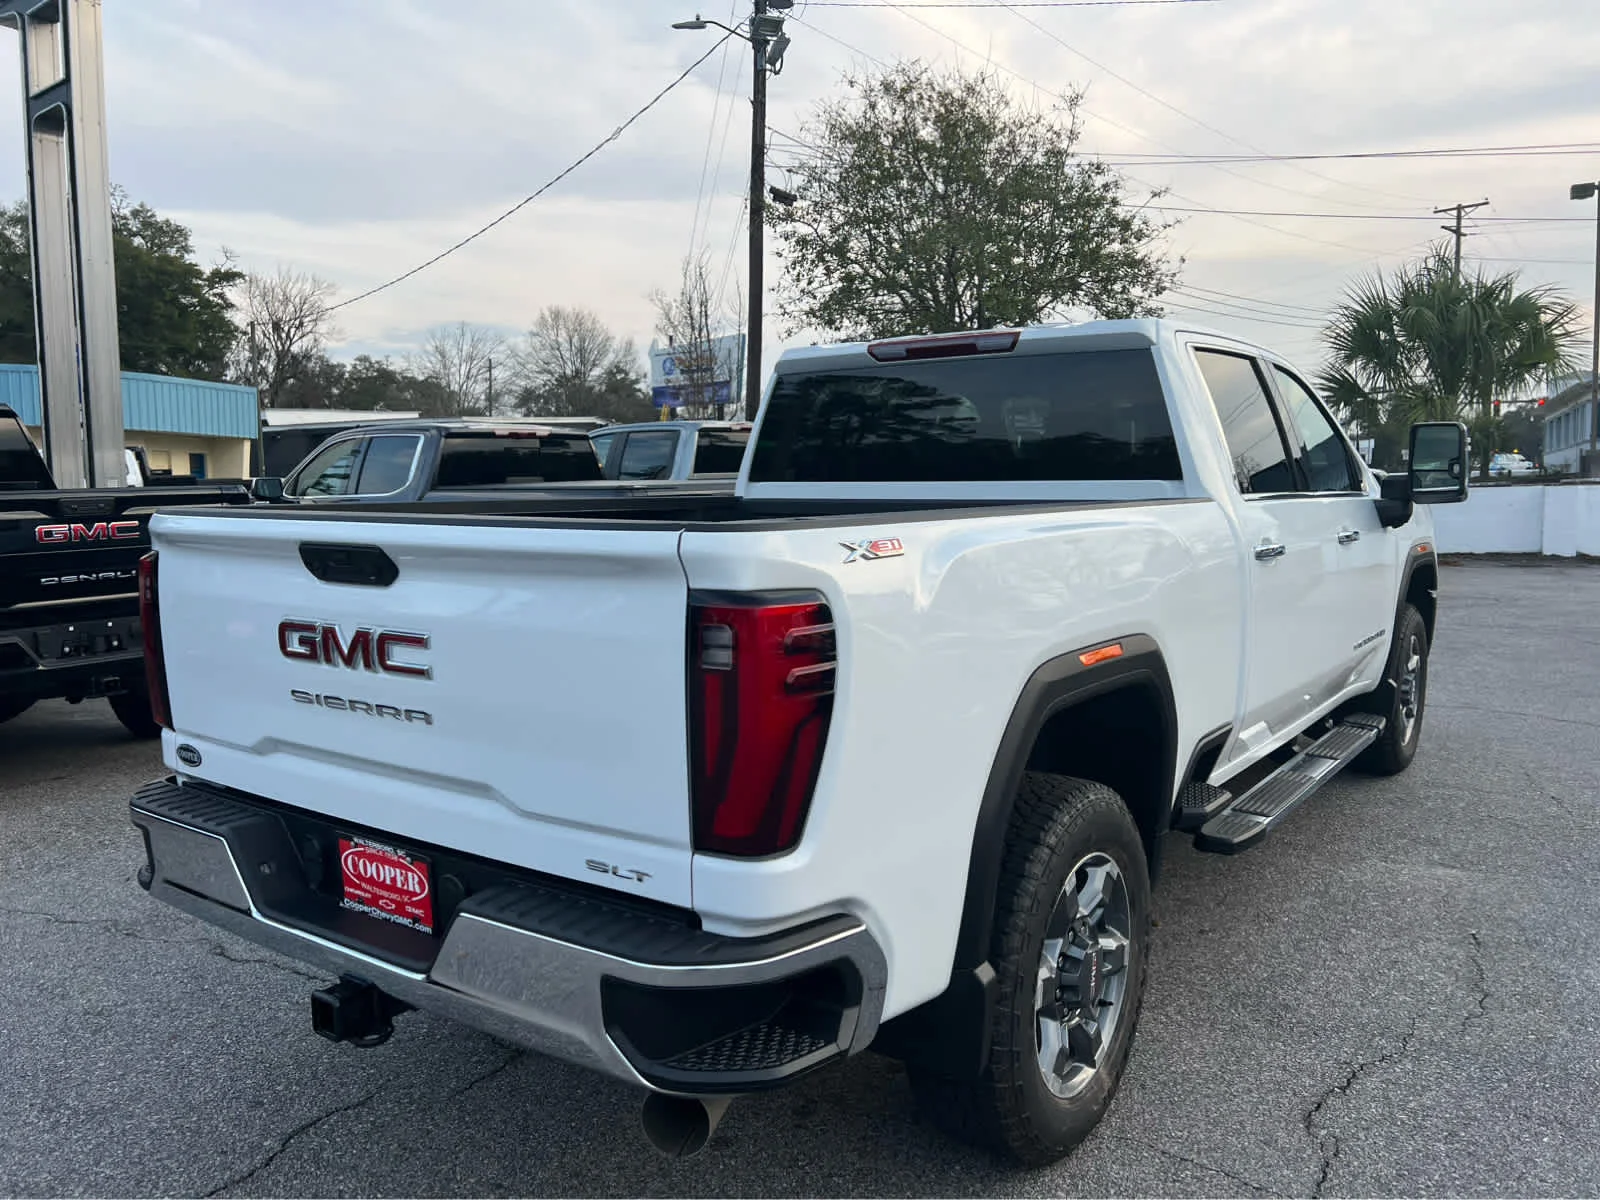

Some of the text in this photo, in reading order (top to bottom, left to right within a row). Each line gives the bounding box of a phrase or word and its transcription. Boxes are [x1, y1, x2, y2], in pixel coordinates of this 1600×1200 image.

[35, 520, 140, 544] GMC
[40, 570, 137, 585] DENALI
[278, 619, 433, 680] GMC
[290, 689, 433, 725] SIERRA
[347, 854, 421, 893] COOPER
[585, 859, 653, 882] SLT
[343, 898, 433, 934] CooperChevyGMC.com
[405, 905, 425, 917] GMC
